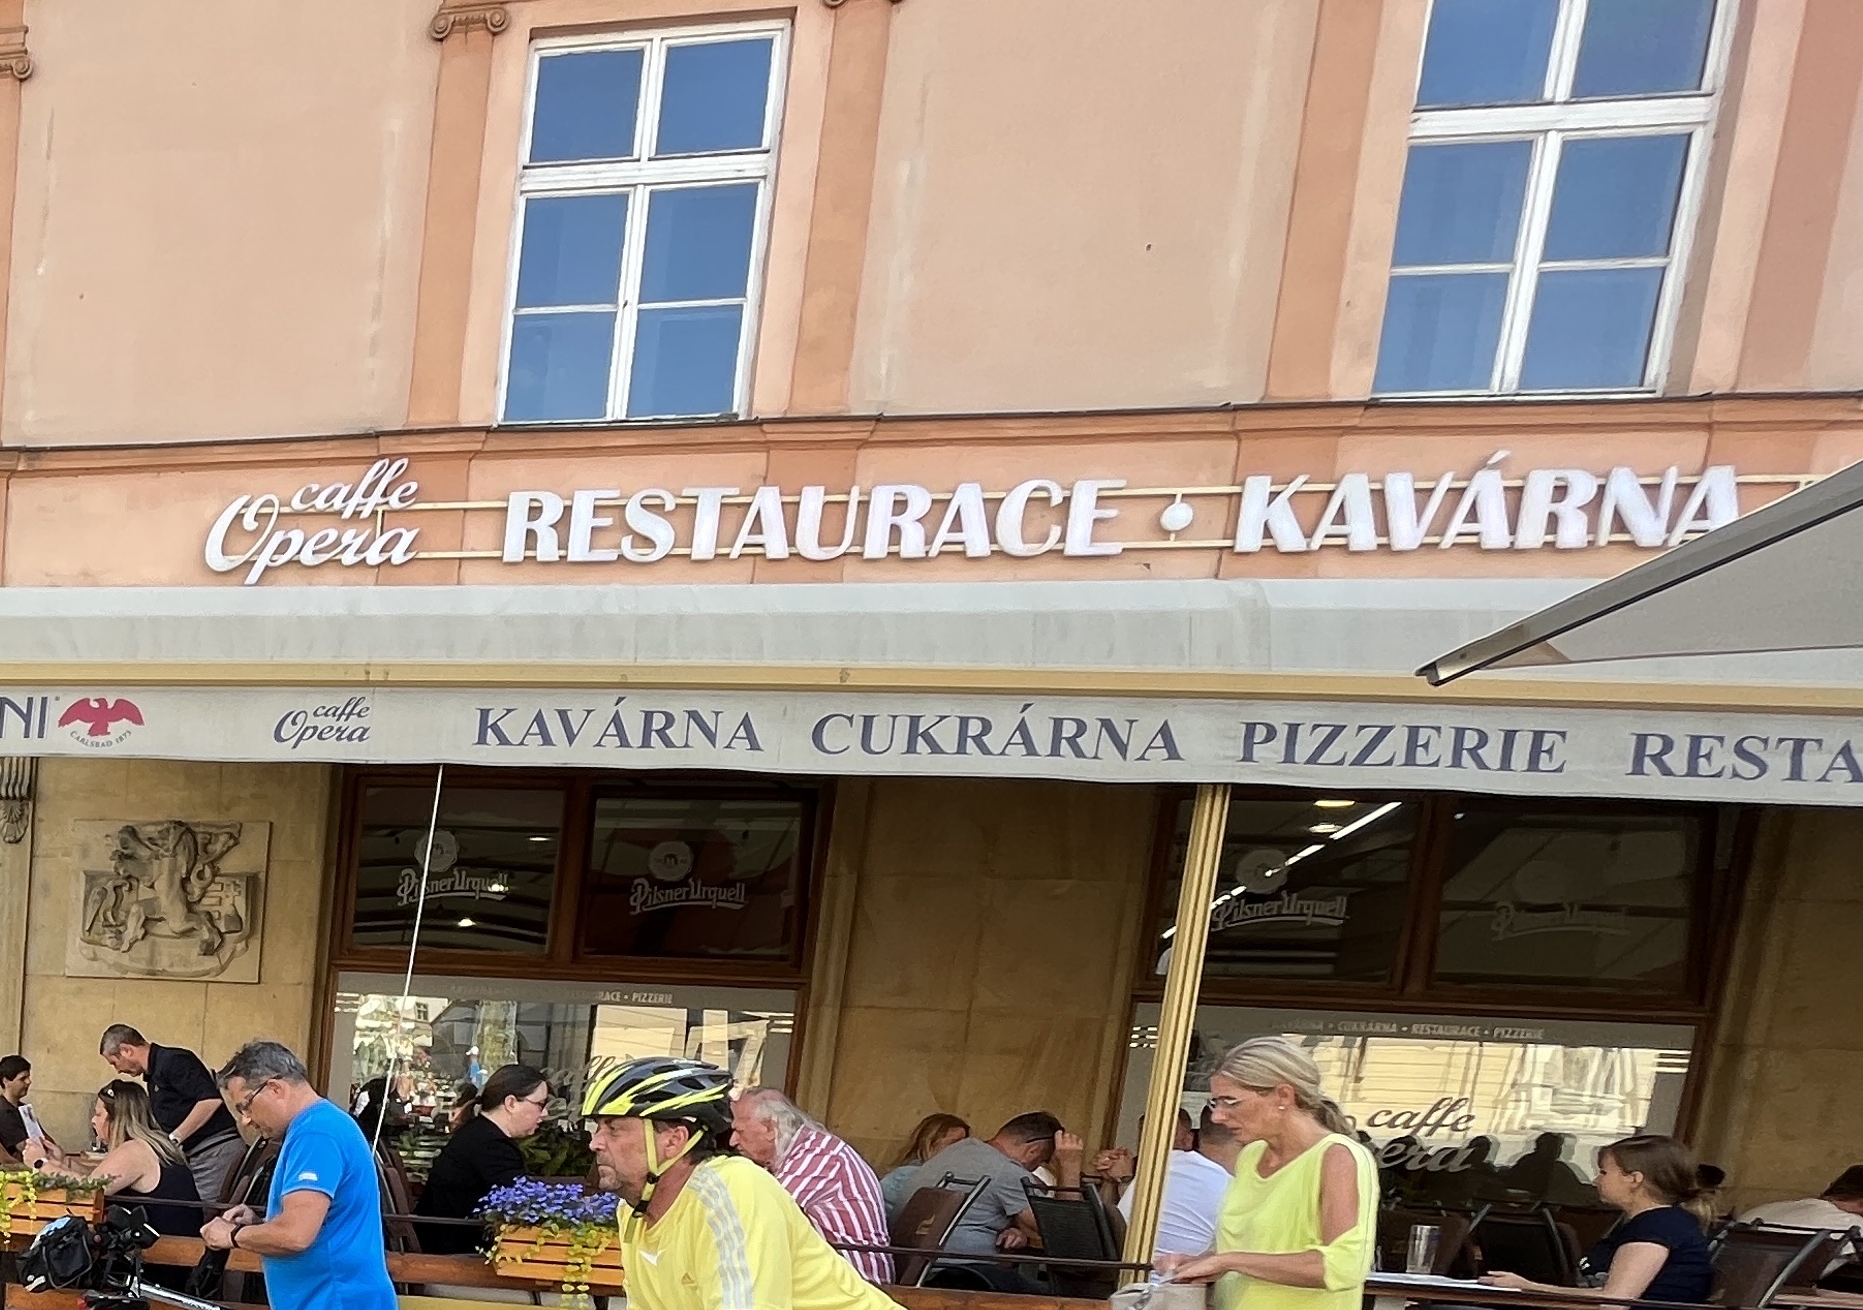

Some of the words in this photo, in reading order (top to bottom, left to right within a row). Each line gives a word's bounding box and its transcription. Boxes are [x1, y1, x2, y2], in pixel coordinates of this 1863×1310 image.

[290, 457, 419, 519] caffe
[502, 479, 1127, 564] RESTAURACE
[1234, 450, 1740, 554] KAVÁRNA
[204, 493, 421, 585] Opera
[273, 709, 372, 750] Opera
[312, 696, 371, 722] caffe
[70, 730, 113, 748] CARLSBAD
[472, 696, 764, 754] KAVÁRNA
[810, 702, 1185, 763] CUKRÁRNA
[1238, 720, 1568, 775] PIZZERIE
[1625, 730, 1863, 785] RESTA
[395, 867, 456, 907] Pisner
[629, 877, 690, 915] Pilsner
[688, 877, 746, 909] Urquell
[1367, 1096, 1477, 1137] caffe
